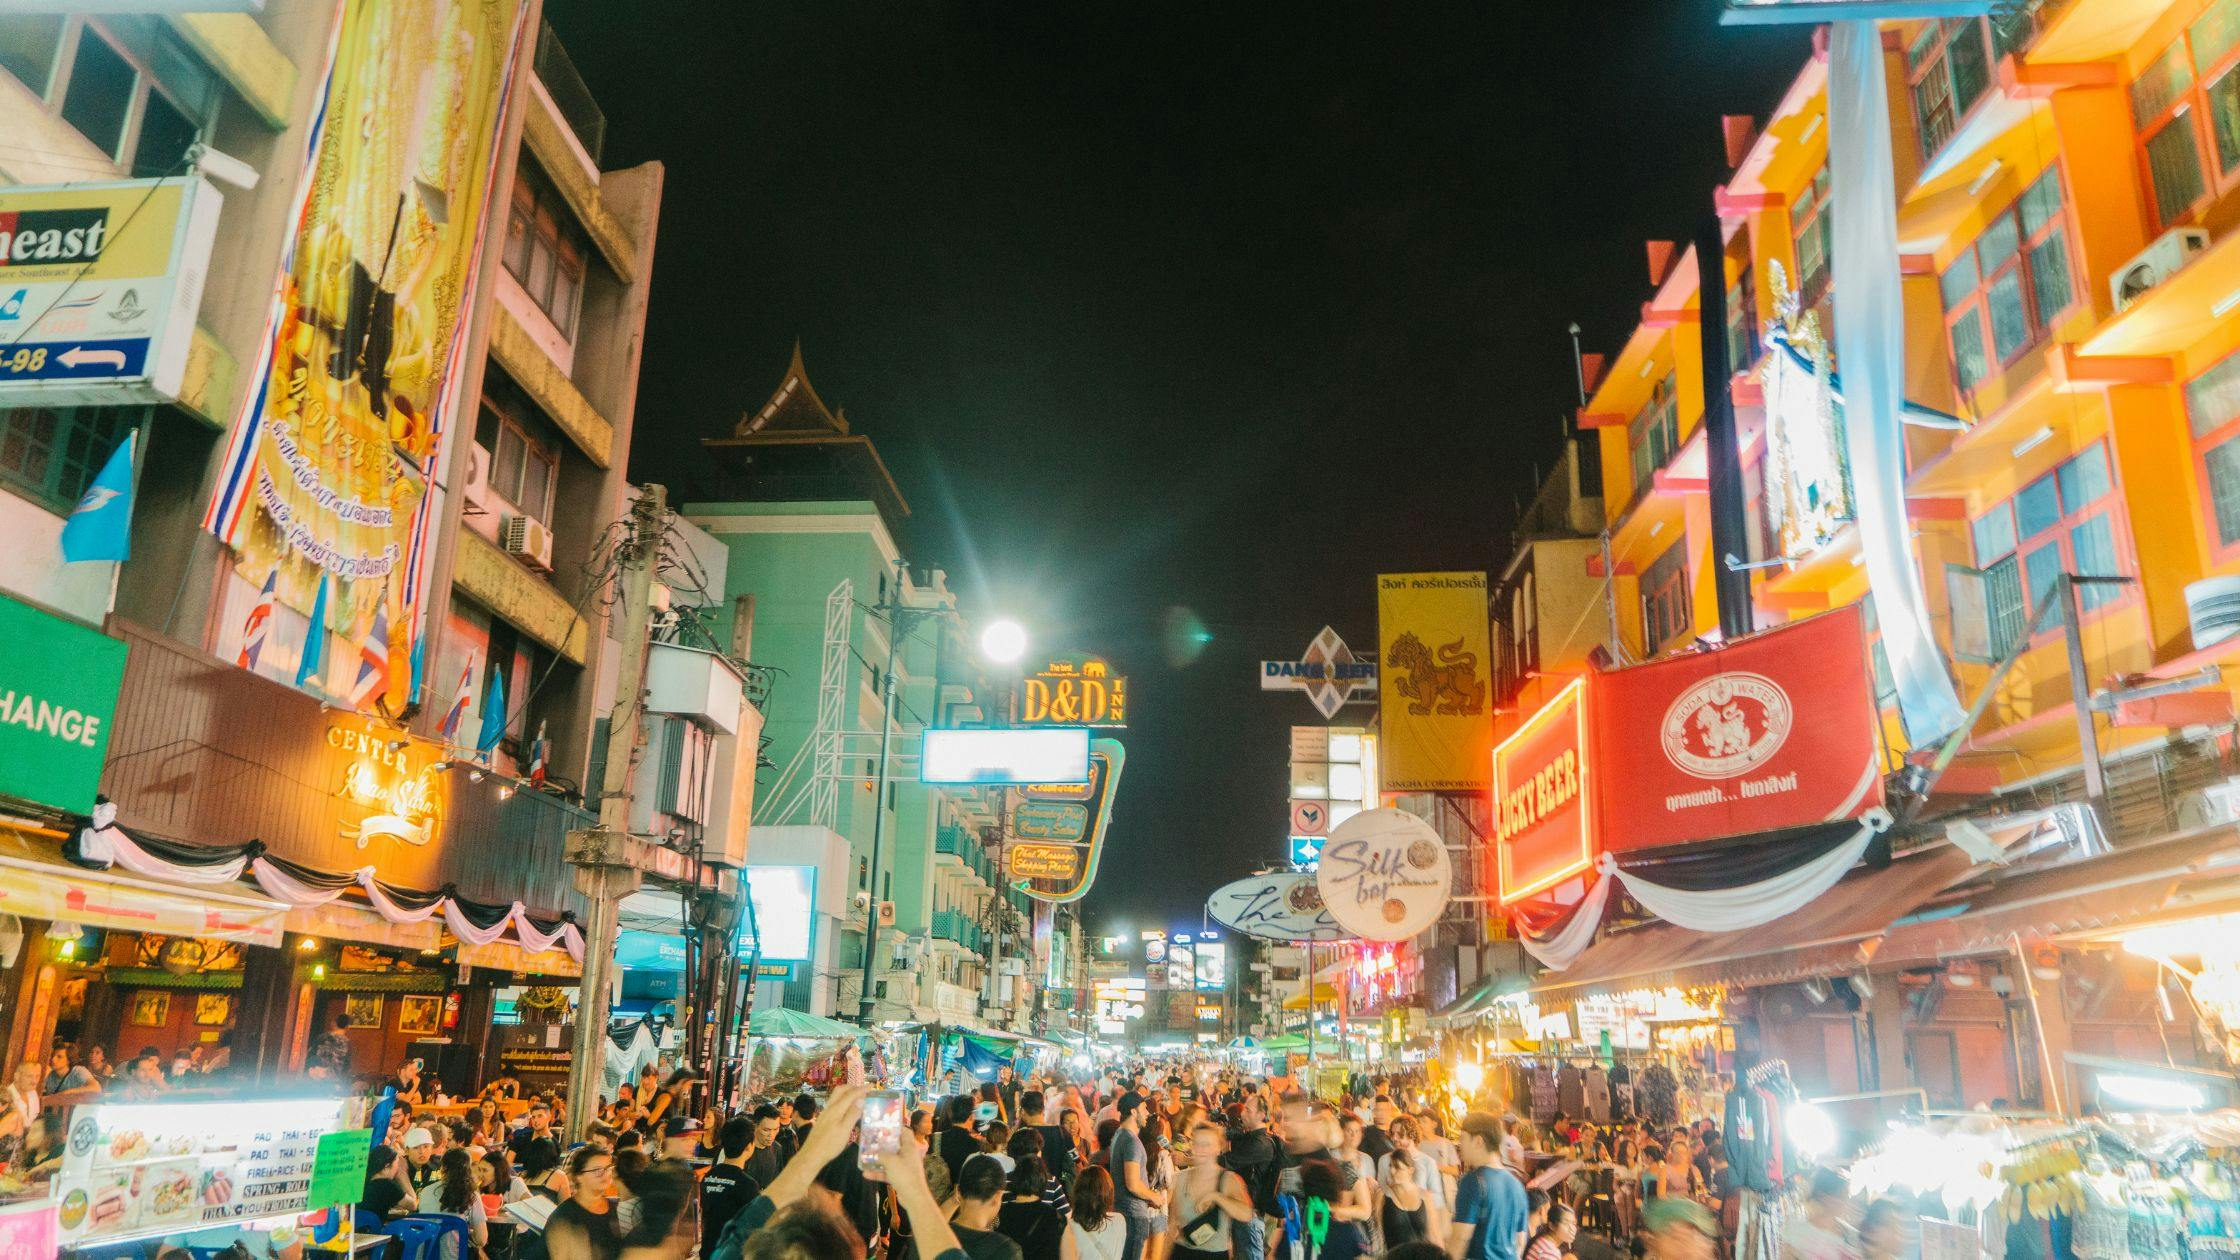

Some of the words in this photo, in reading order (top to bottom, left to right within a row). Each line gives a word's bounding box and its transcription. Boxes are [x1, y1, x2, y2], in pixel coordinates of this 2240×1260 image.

[1023, 679, 1107, 723] D&D
[1110, 680, 1124, 721] INN
[1676, 696, 1703, 722] SODA
[1737, 682, 1777, 704] WATER
[327, 726, 407, 774] CENTER
[1386, 779, 1423, 789] SINGHA
[1496, 777, 1535, 842] LUCKY
[1536, 748, 1577, 818] BEER
[1329, 840, 1407, 882] Silk
[650, 979, 667, 987] ATM
[250, 1150, 269, 1161] PAD
[279, 1148, 297, 1160] THAI
[254, 1132, 271, 1142] PAD
[282, 1130, 299, 1141] THAI
